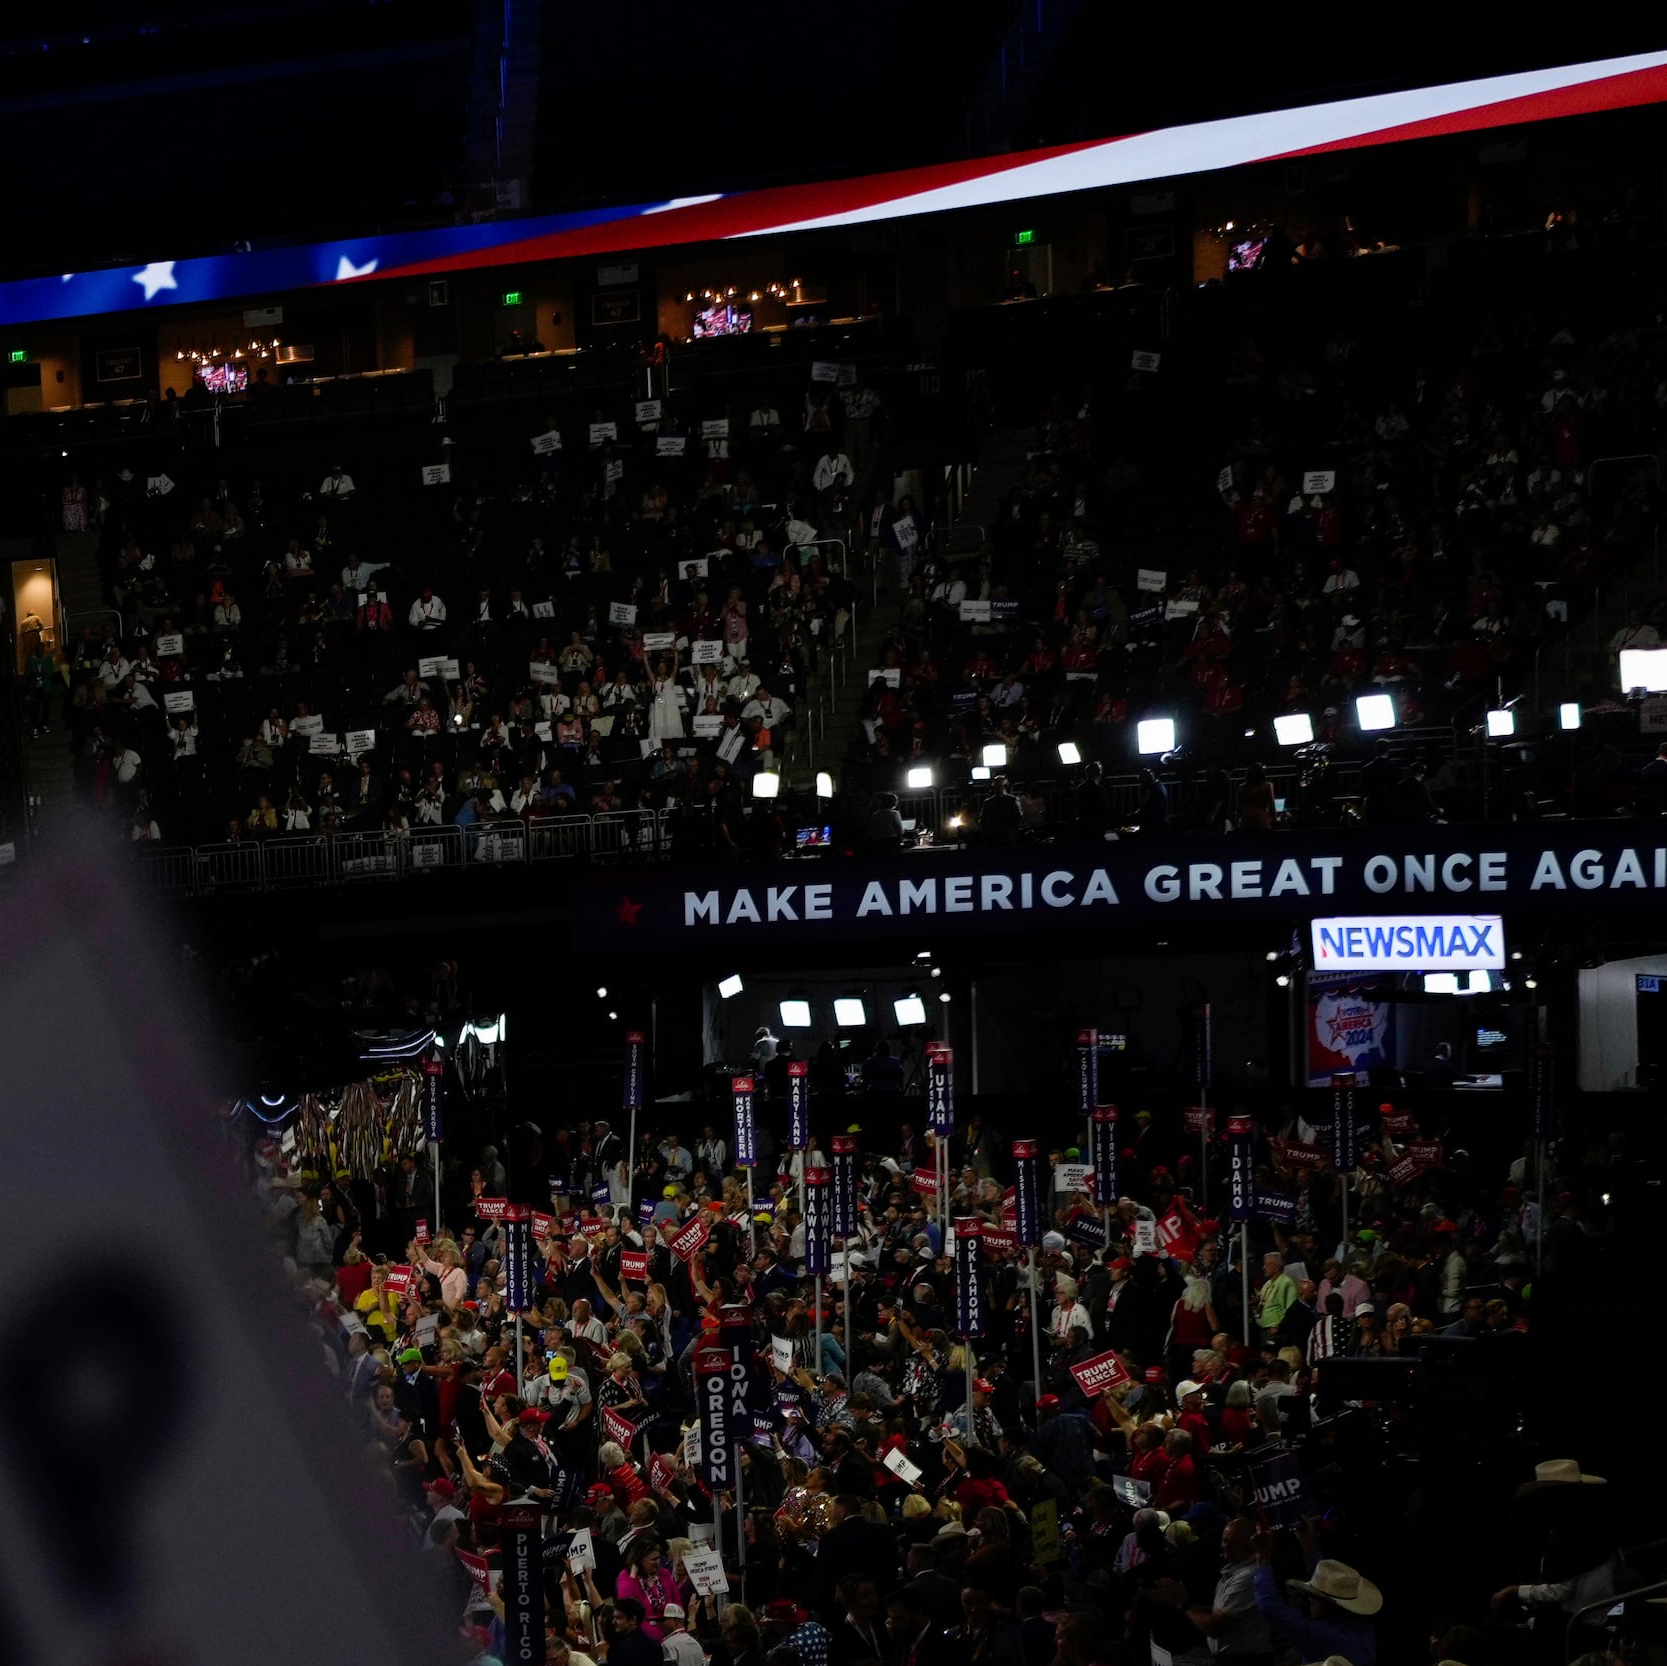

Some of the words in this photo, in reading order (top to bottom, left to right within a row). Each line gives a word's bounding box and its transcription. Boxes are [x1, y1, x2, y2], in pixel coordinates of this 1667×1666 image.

[683, 882, 833, 927] MAKE
[856, 868, 1120, 918] AMERICA
[1143, 855, 1343, 903] GREAT
[1363, 851, 1509, 896] ONCE
[1319, 925, 1499, 958] NEWSMAX
[1346, 1029, 1373, 1047] 2024
[735, 1096, 747, 1159] NORTHERN
[791, 1077, 801, 1146] MARYLAND
[935, 1074, 946, 1125] UTAH
[1096, 1122, 1104, 1202] VIRGINIA
[1108, 1122, 1116, 1201] VIRGINIA
[1231, 1143, 1243, 1209] IDAHO
[1286, 1149, 1322, 1161] TRUMP
[806, 1187, 817, 1268] HAWAII
[1258, 1197, 1294, 1209] TRUMP
[507, 1223, 515, 1307] MINNESOTA
[621, 1260, 645, 1269] TRUMP
[671, 1222, 701, 1249] TRUMP
[982, 1235, 1013, 1246] TRUMP
[968, 1239, 978, 1331] OKLAHOMA
[731, 1345, 748, 1417] IOWA
[1077, 1359, 1116, 1382] TRUMP
[1086, 1369, 1117, 1386] VANCE
[707, 1376, 727, 1482] OREGON
[516, 1533, 530, 1606] PUERTO
[519, 1611, 532, 1660] RICO
